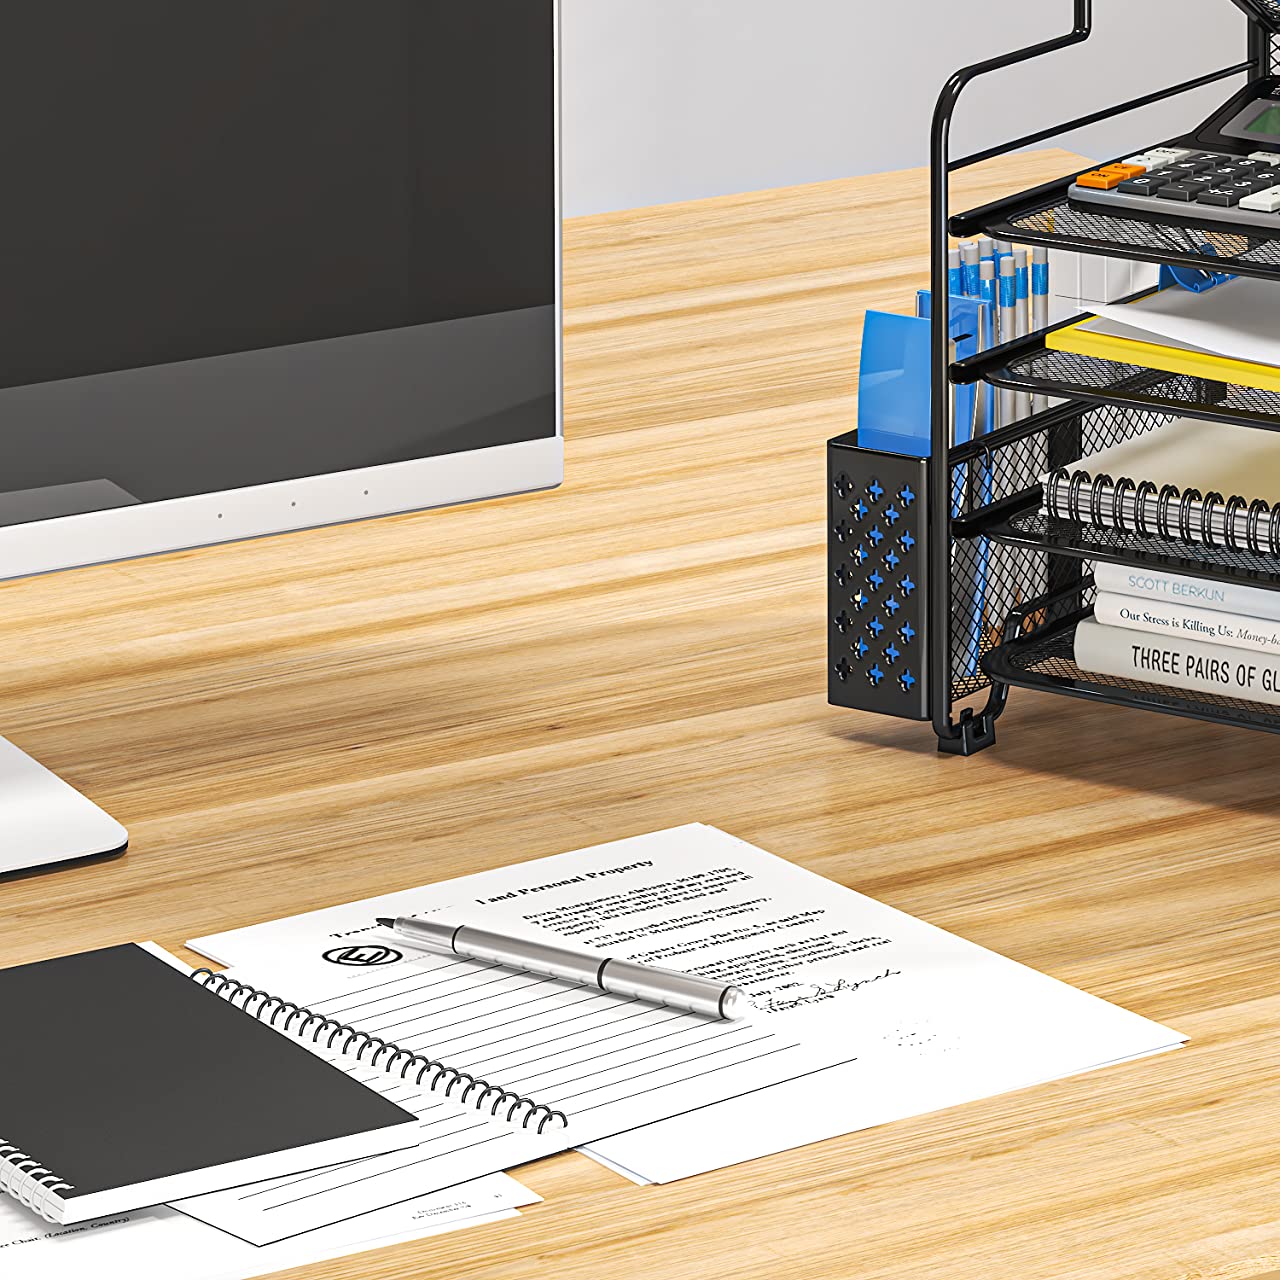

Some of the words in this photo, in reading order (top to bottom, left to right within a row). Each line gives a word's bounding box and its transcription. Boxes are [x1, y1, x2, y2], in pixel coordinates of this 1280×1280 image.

[1128, 575, 1169, 593] SCOTT
[1172, 583, 1225, 603] BERKUN
[1120, 608, 1140, 622] Our
[1143, 611, 1170, 627] Stress
[1172, 617, 1180, 629] is
[1182, 618, 1216, 637] Killing
[1218, 624, 1234, 638] Us:
[1132, 645, 1180, 675] THREE
[1186, 656, 1230, 684] PAIRS
[1236, 664, 1256, 688] OF
[488, 892, 518, 902] and
[517, 876, 586, 895] Personal
[585, 860, 653, 878] Property
[543, 914, 562, 922] and
